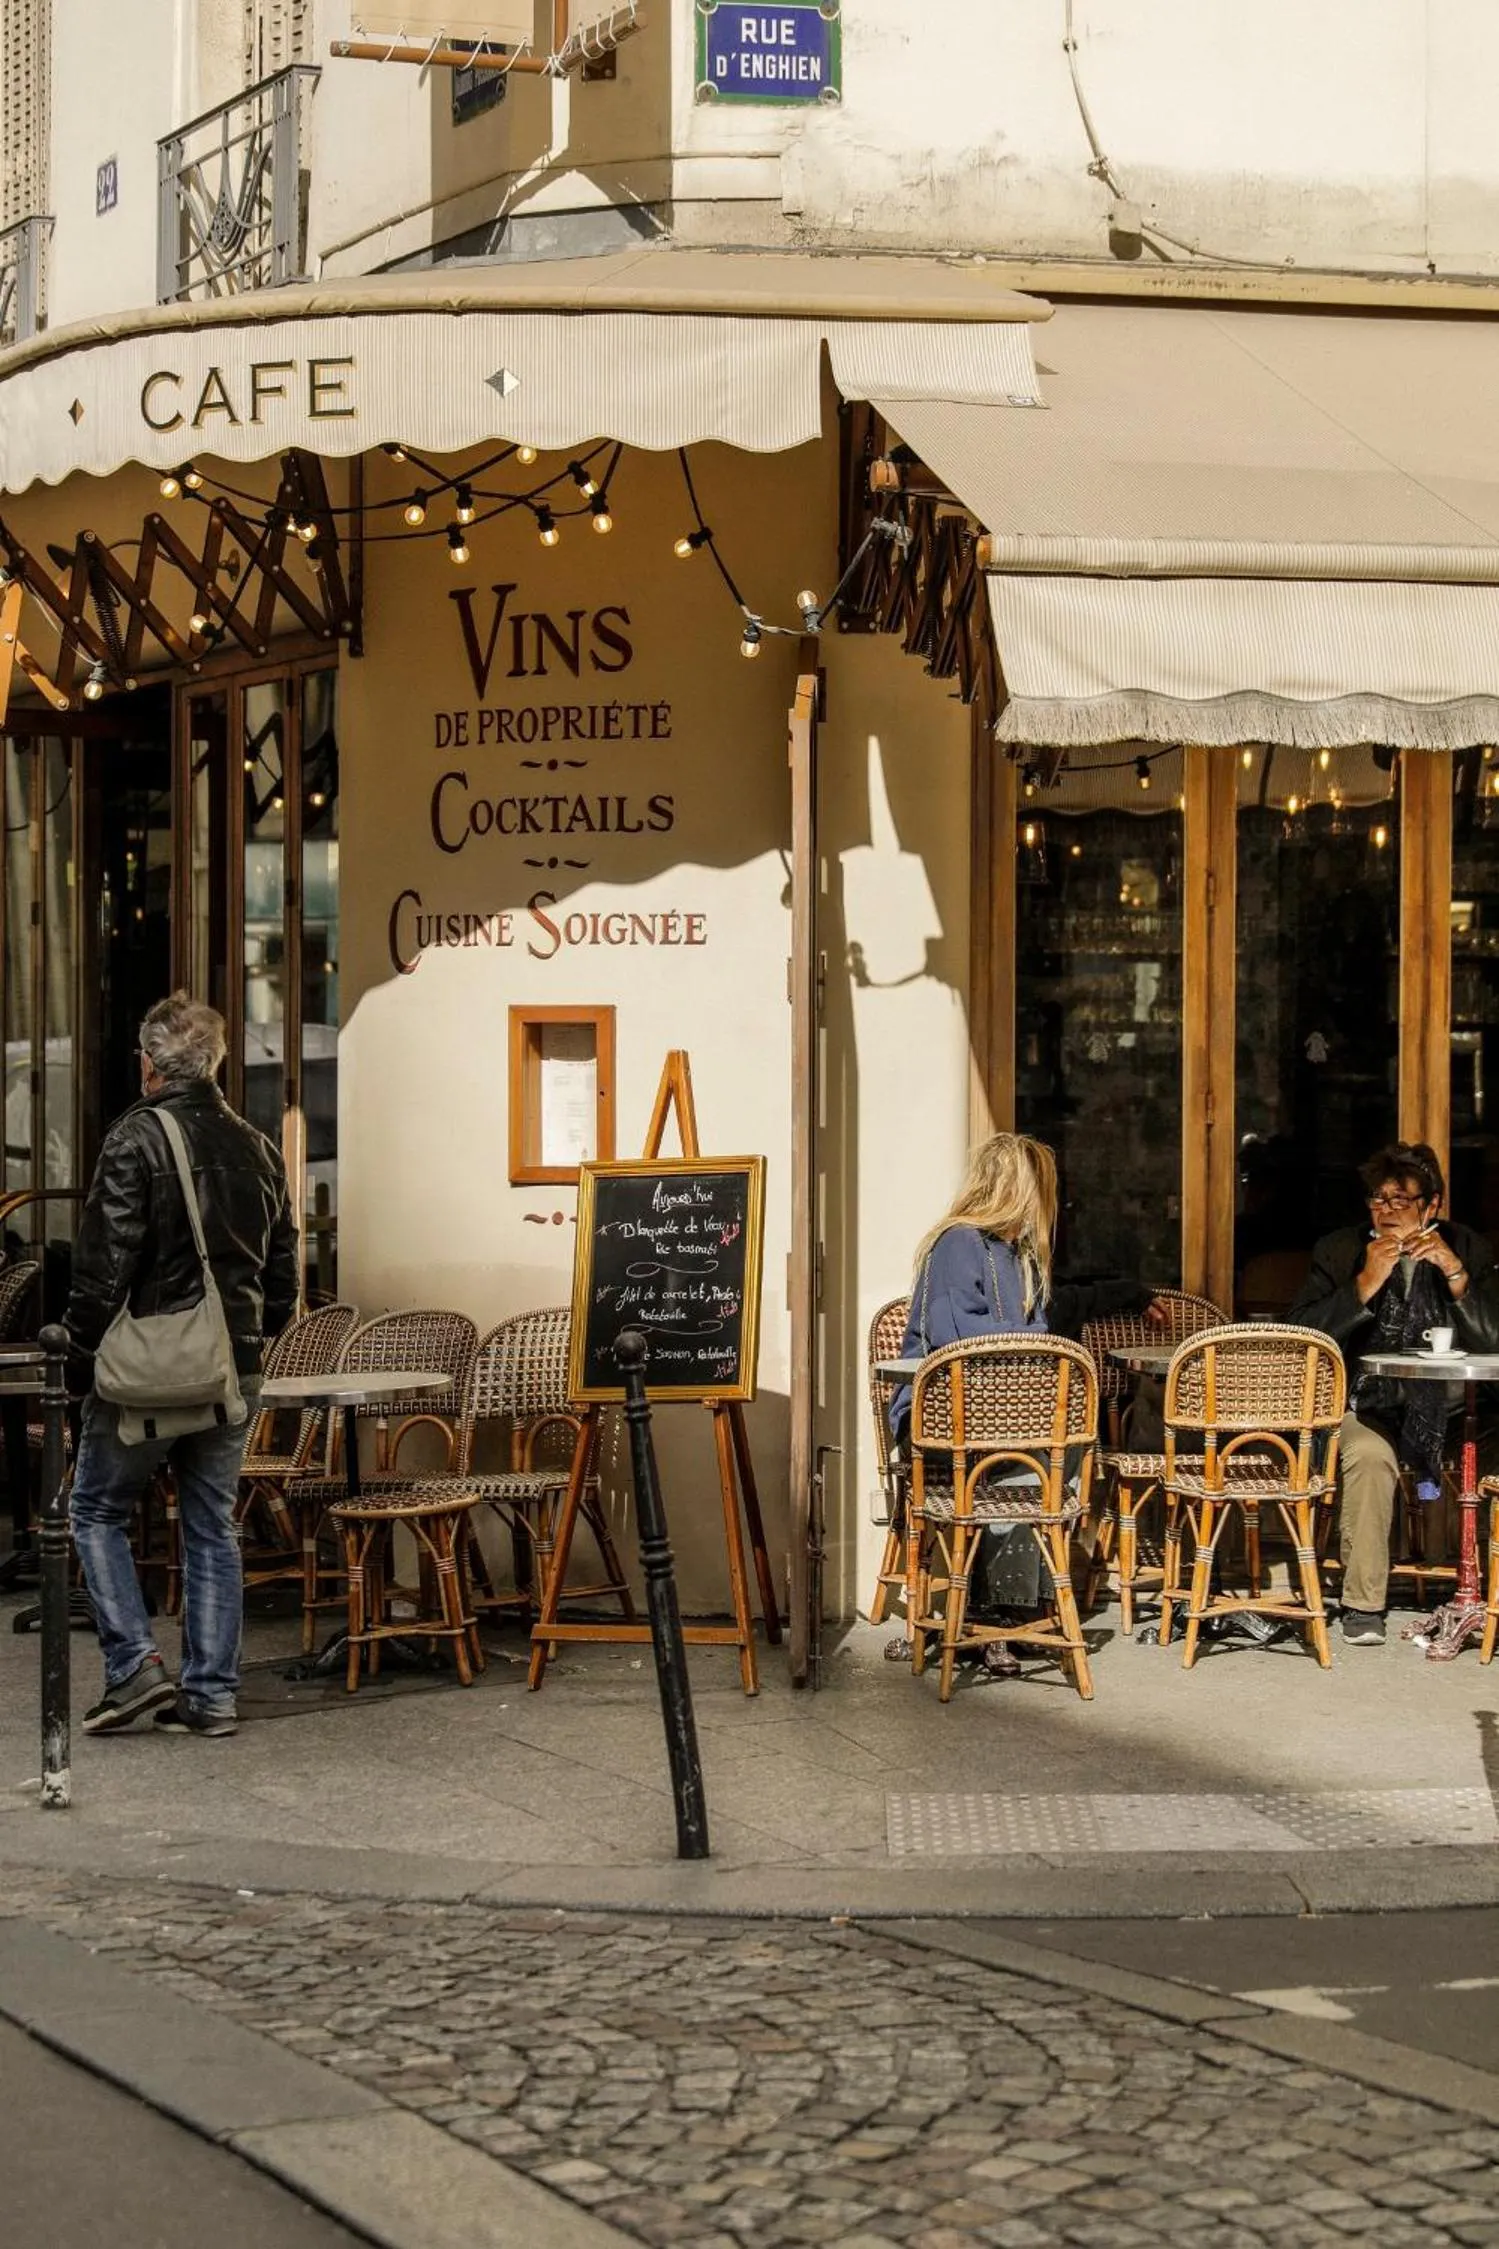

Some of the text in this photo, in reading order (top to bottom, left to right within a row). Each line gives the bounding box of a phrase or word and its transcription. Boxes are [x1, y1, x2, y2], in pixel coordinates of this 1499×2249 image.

[741, 17, 796, 45] RUE
[715, 53, 821, 81] D'ENGHIEN
[140, 356, 358, 433] CAFE
[434, 700, 673, 749] DE PROPRIÉTÉ
